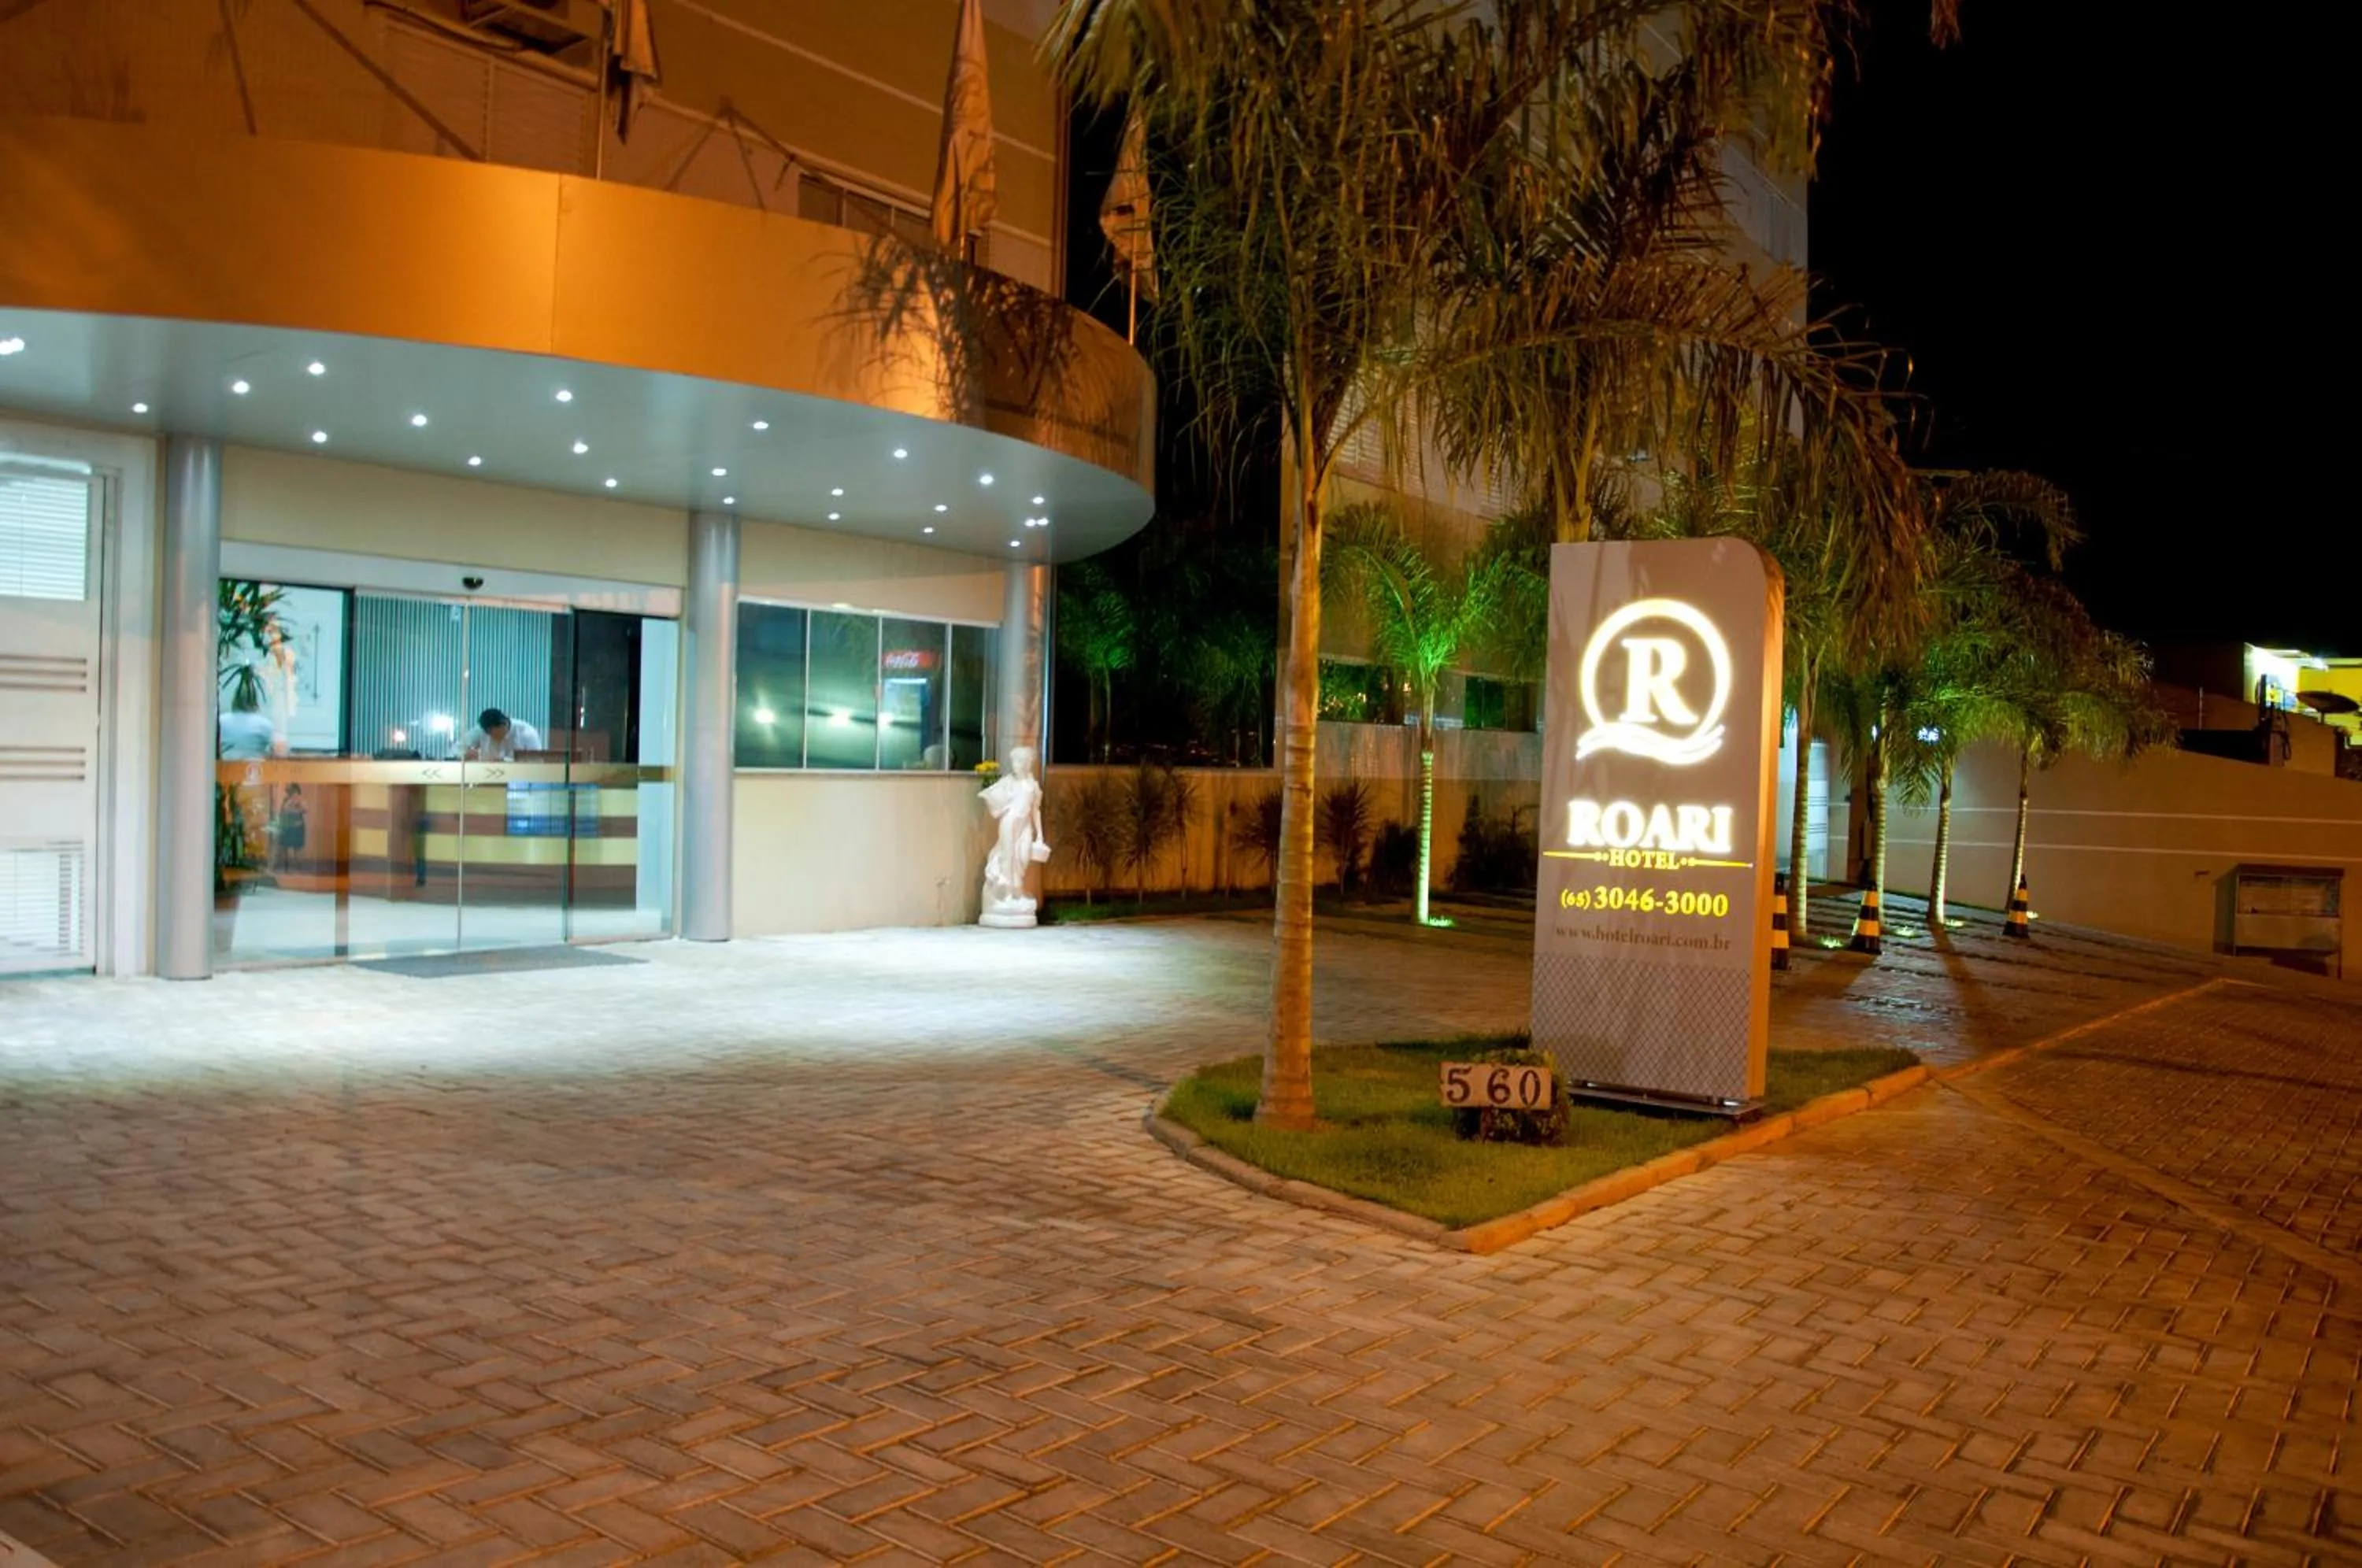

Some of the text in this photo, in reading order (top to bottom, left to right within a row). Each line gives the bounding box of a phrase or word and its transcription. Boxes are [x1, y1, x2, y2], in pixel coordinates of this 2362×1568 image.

[1619, 638, 1699, 725] R
[1567, 800, 1733, 853] ROARI
[1609, 848, 1679, 870] HOTEL
[1560, 886, 1729, 918] (65) 3046-3000
[1556, 924, 1731, 951] www.hotelroari.com.br
[1446, 1066, 1541, 1107] 560
